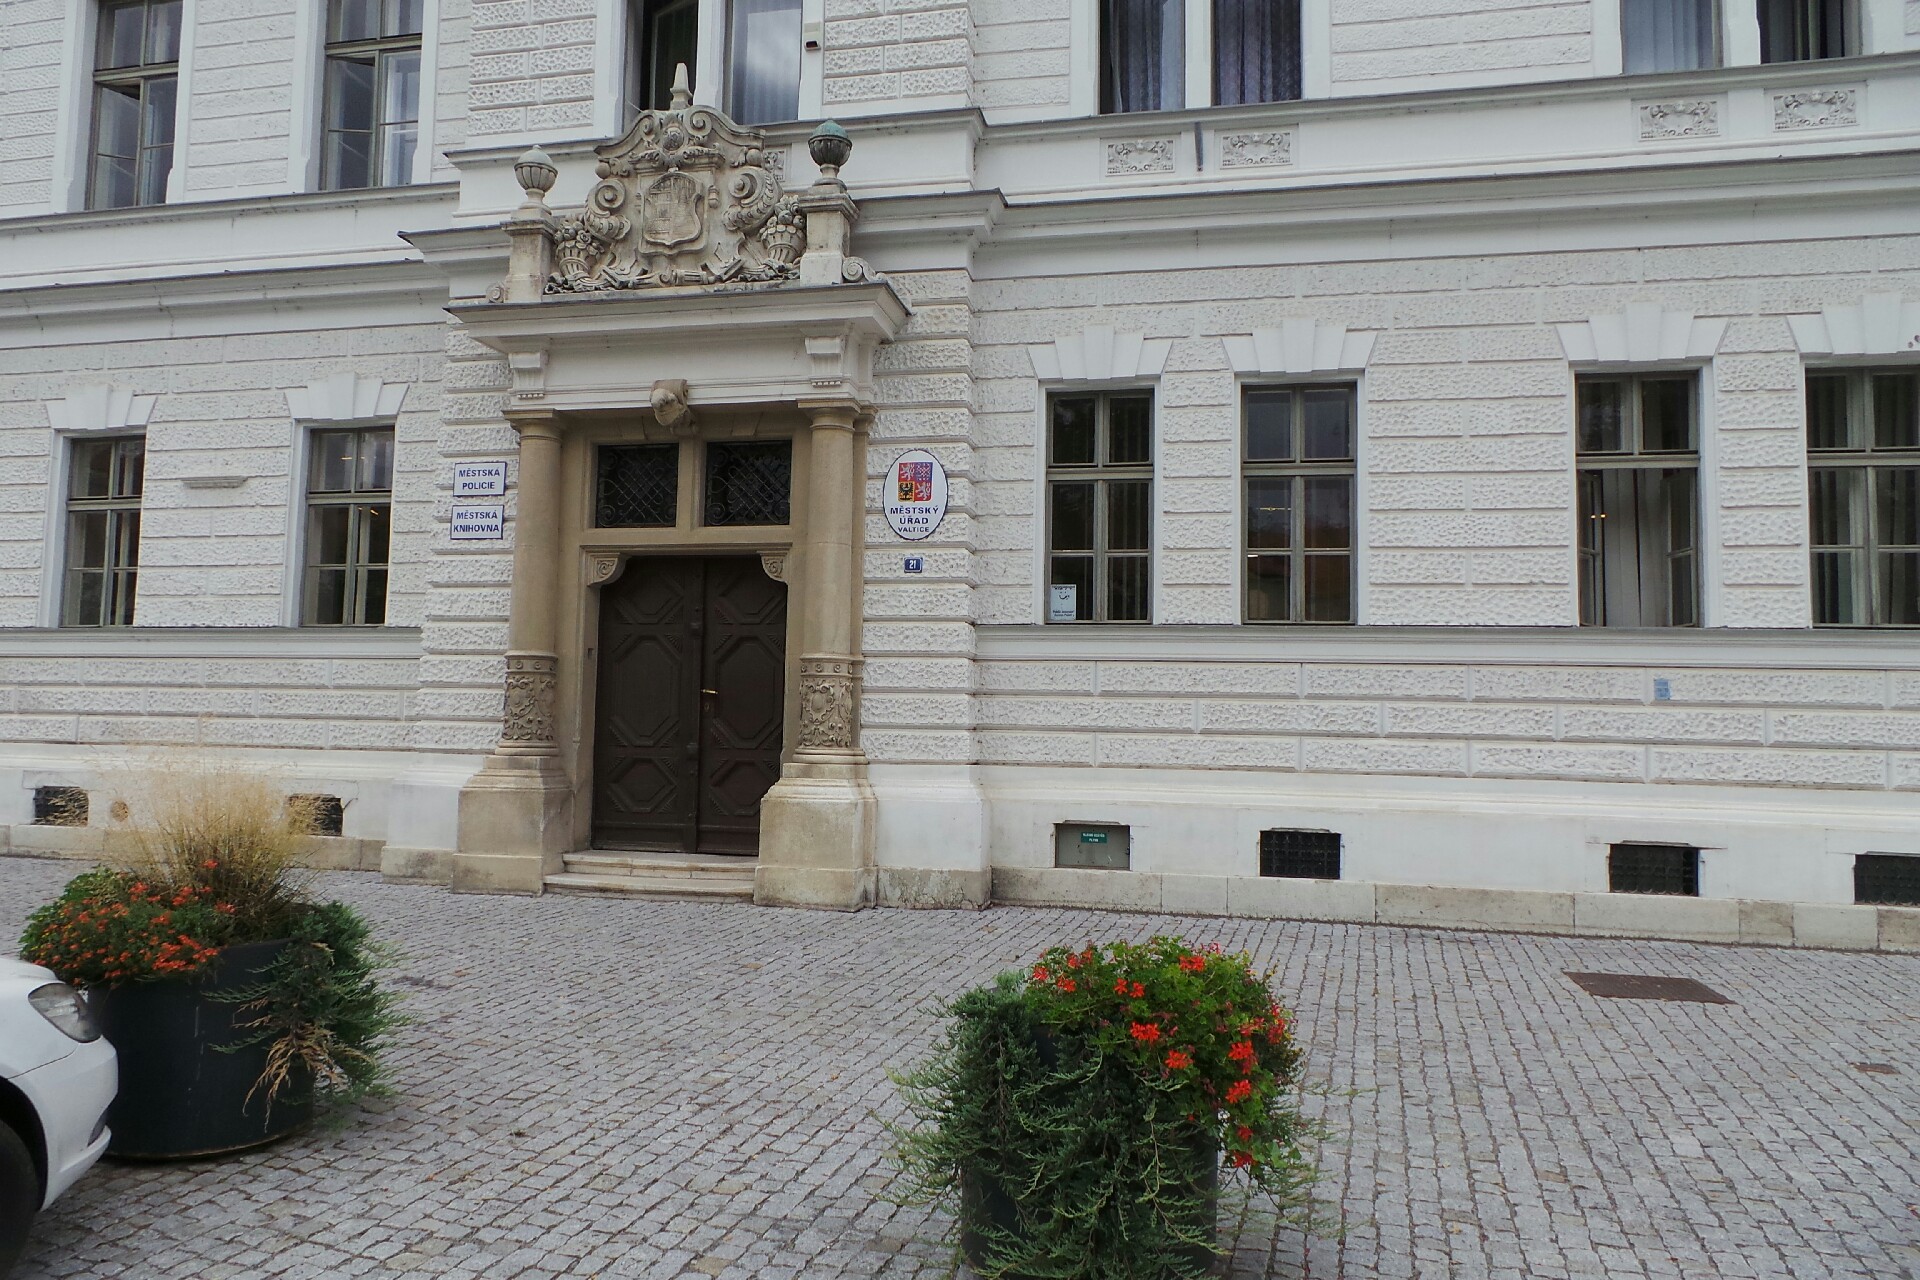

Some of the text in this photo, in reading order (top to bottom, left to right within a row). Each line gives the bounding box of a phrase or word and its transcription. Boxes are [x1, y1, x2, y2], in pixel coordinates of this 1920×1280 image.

[458, 467, 500, 477] MĚSTSKÁ
[462, 482, 495, 490] POLICIE
[890, 505, 939, 514] MĚSTSKÝ
[456, 510, 498, 519] MĚSTSKÁ
[899, 515, 929, 525] ÚŘAD
[453, 524, 500, 532] KNIHOVNA
[909, 560, 917, 569] 21
